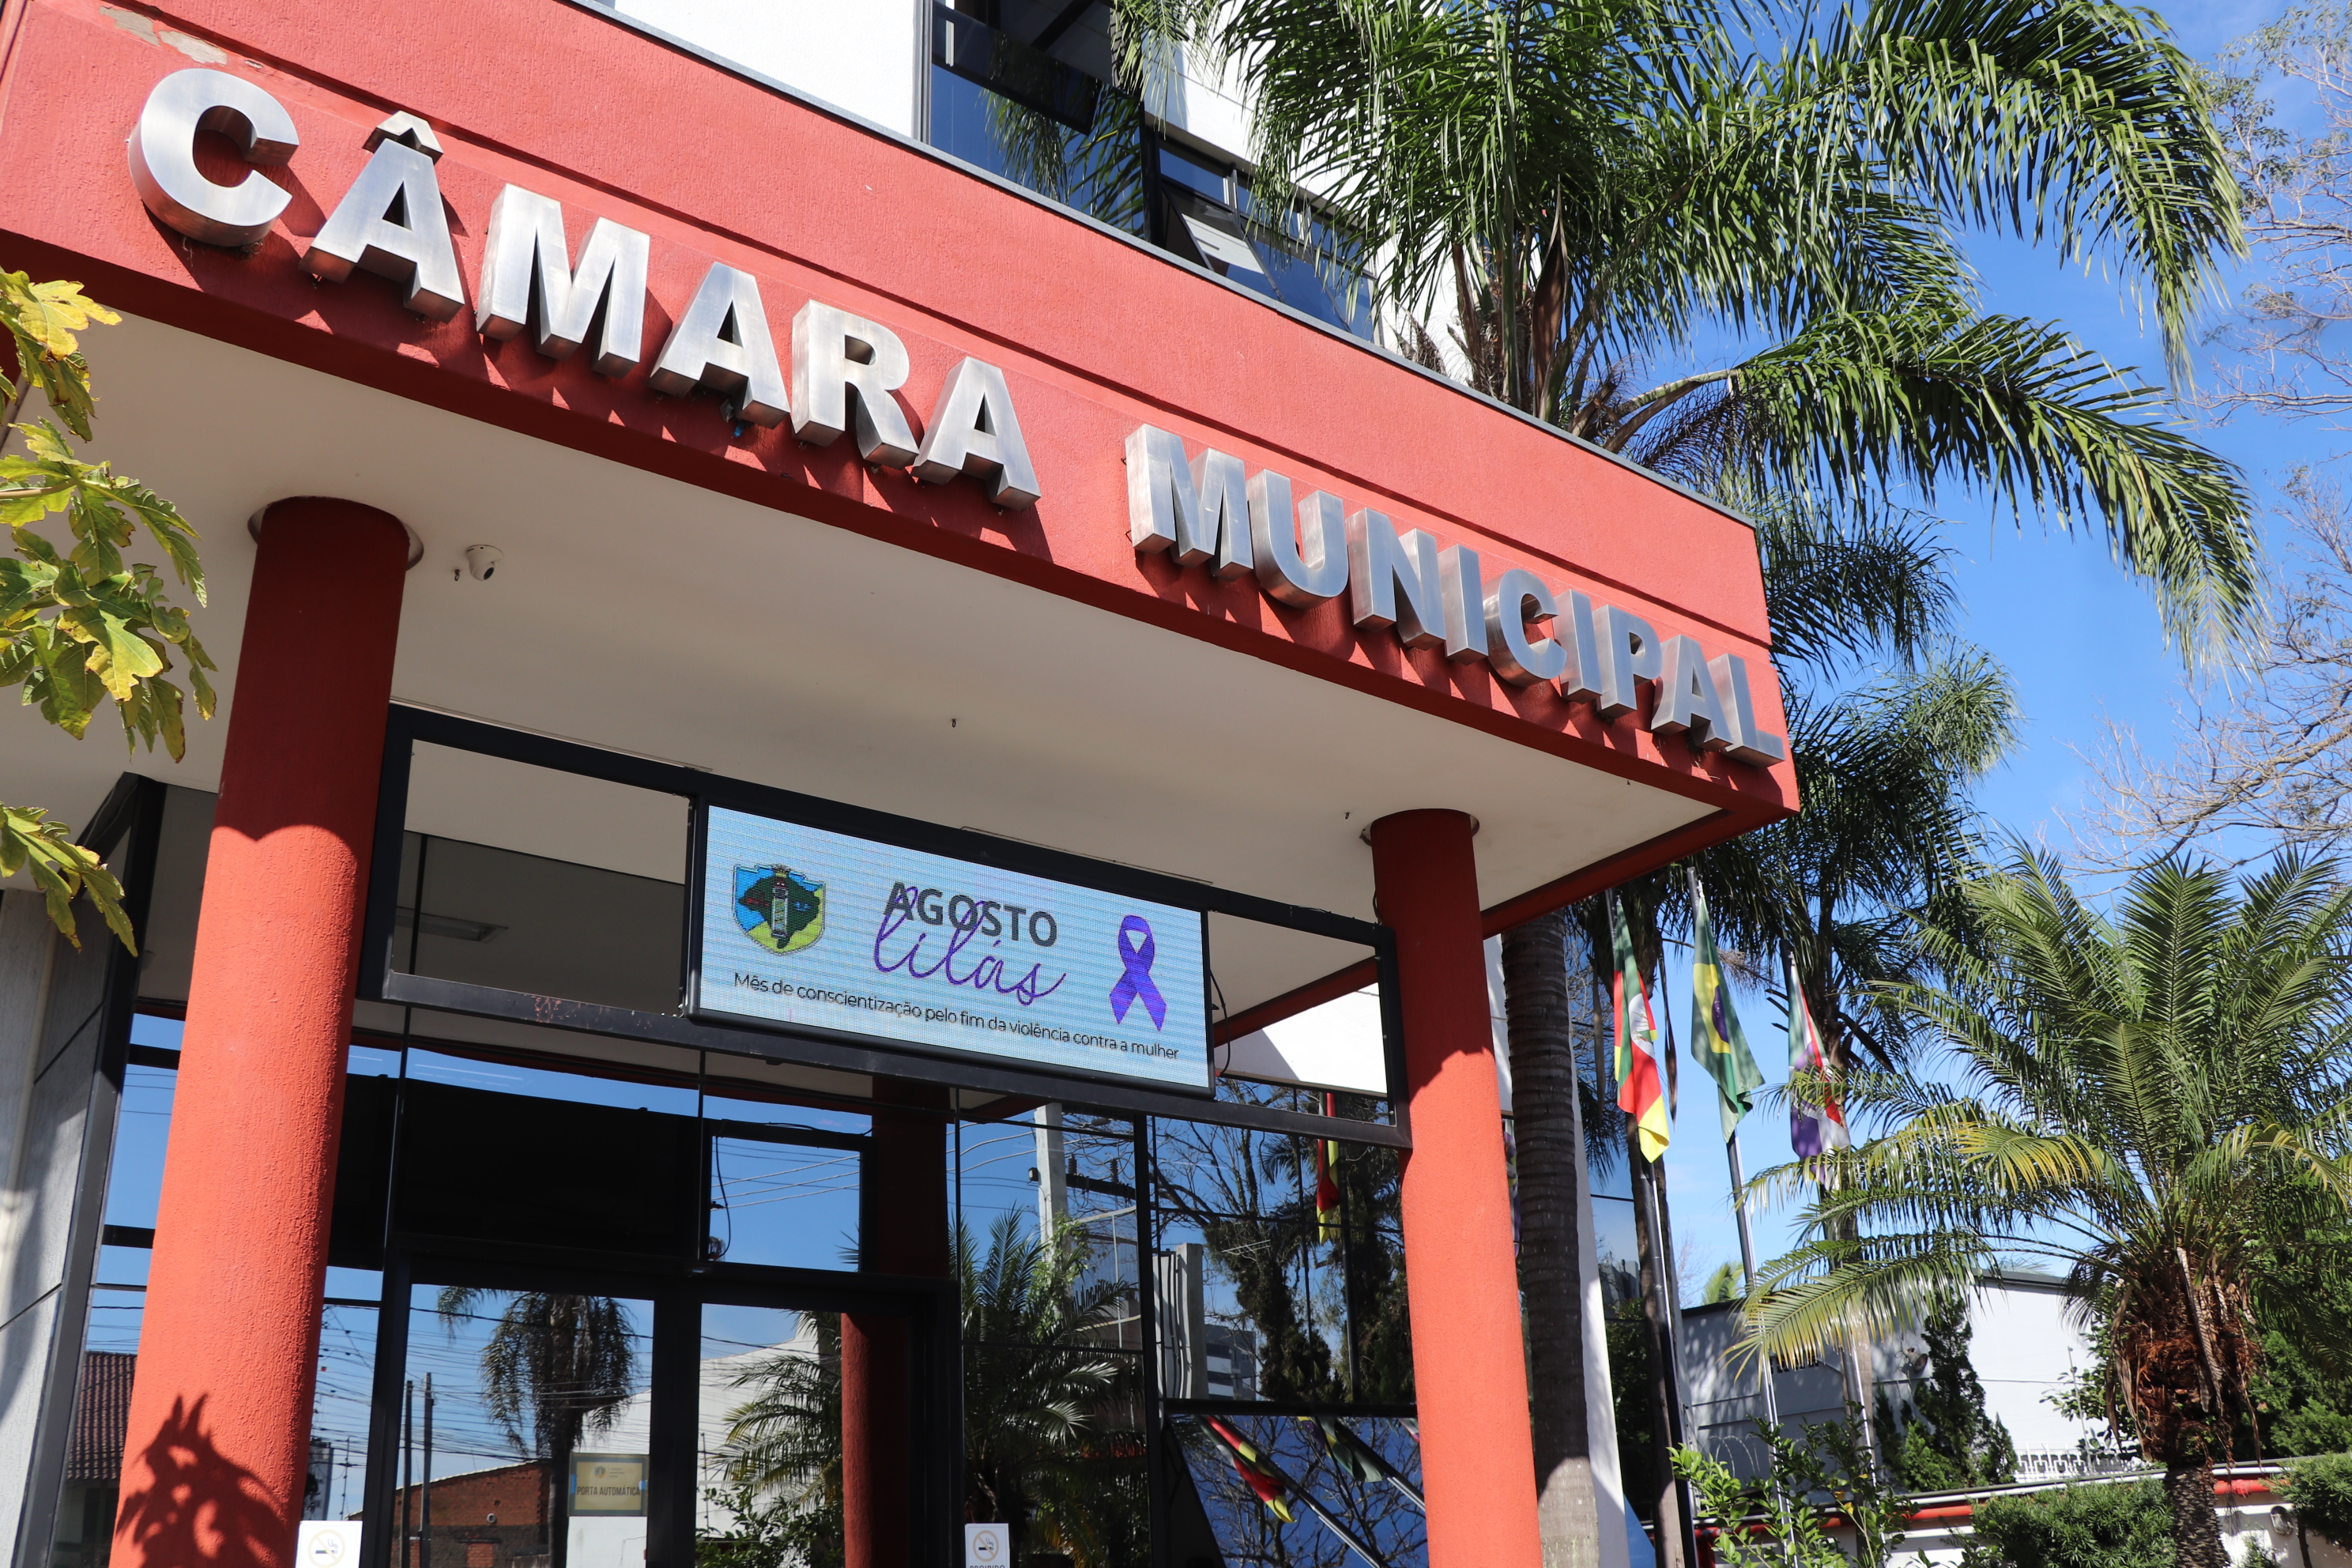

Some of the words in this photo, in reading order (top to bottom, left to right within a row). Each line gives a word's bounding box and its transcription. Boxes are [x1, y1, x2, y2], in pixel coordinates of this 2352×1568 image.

[129, 68, 1042, 511] CÂMARA
[1125, 423, 1785, 767] MUNICIPAL
[874, 886, 1067, 1006] lilás
[884, 881, 1057, 948] AGOSTO
[734, 972, 769, 993] Mês
[771, 979, 793, 996] de
[797, 985, 922, 1018] conscientização
[925, 1007, 958, 1025] pelo
[960, 1011, 985, 1028] fim
[988, 1016, 1007, 1032] da
[1008, 1020, 1070, 1042] violência
[1072, 1031, 1118, 1050] contra
[1119, 1040, 1129, 1052] a
[1130, 1042, 1179, 1060] mulher
[577, 1486, 597, 1495] PORTA
[599, 1485, 641, 1496] AUTOMÁTICA
